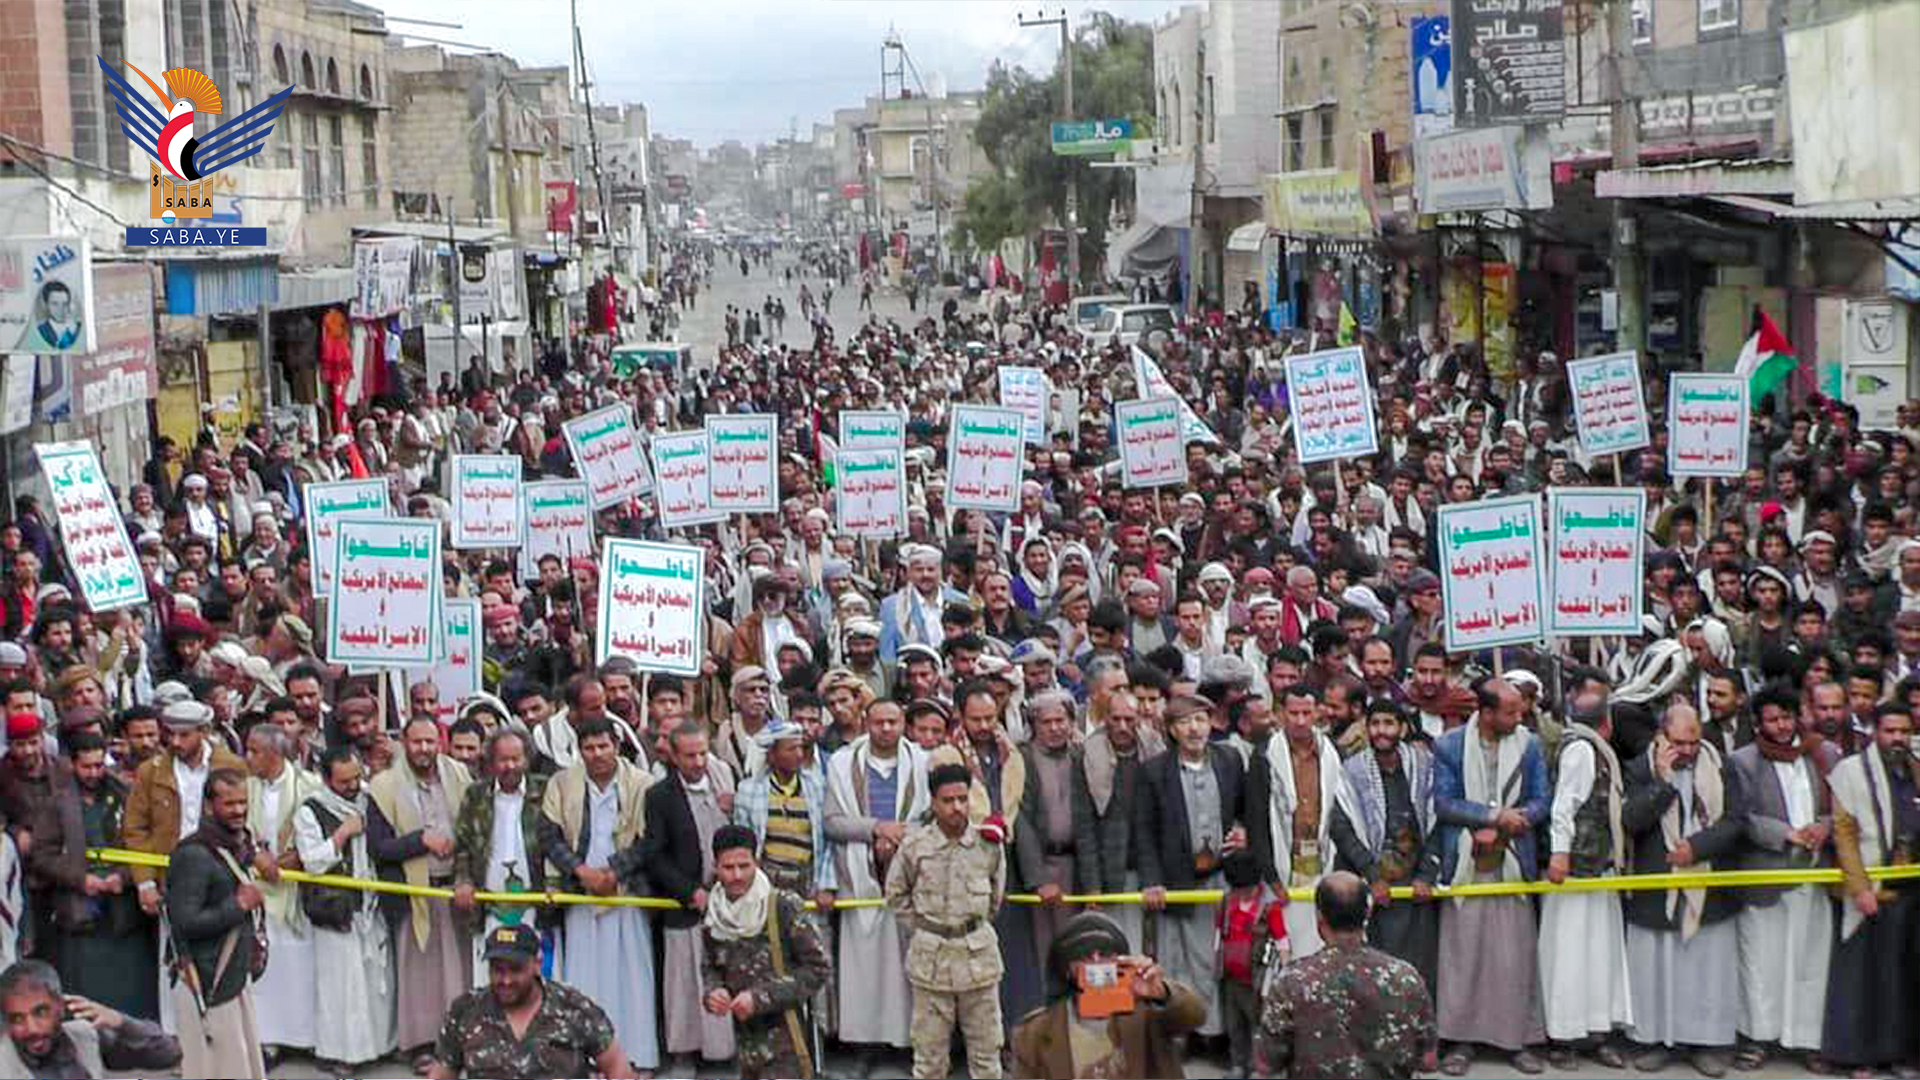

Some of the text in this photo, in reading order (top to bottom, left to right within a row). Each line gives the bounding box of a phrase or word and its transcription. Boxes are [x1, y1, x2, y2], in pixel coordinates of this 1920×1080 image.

[1475, 19, 1537, 46] صلاح
[1679, 384, 1738, 405] قاطعوا
[848, 420, 898, 439] قاطعوا
[960, 417, 1018, 437] قاطعوا
[1125, 408, 1174, 428] قاطعوا
[574, 415, 627, 447] قاطعوا
[712, 426, 768, 445] قاطعوا
[463, 465, 513, 483] قاطعوا
[840, 454, 896, 475] قاطعوا
[314, 490, 382, 517] قاطعوا
[530, 489, 585, 512] قاطعوا
[1560, 504, 1636, 533] قاطعوا
[1447, 513, 1531, 550] قاطعوا
[343, 532, 428, 561] قاطعوا
[615, 553, 694, 580] قاطعوا
